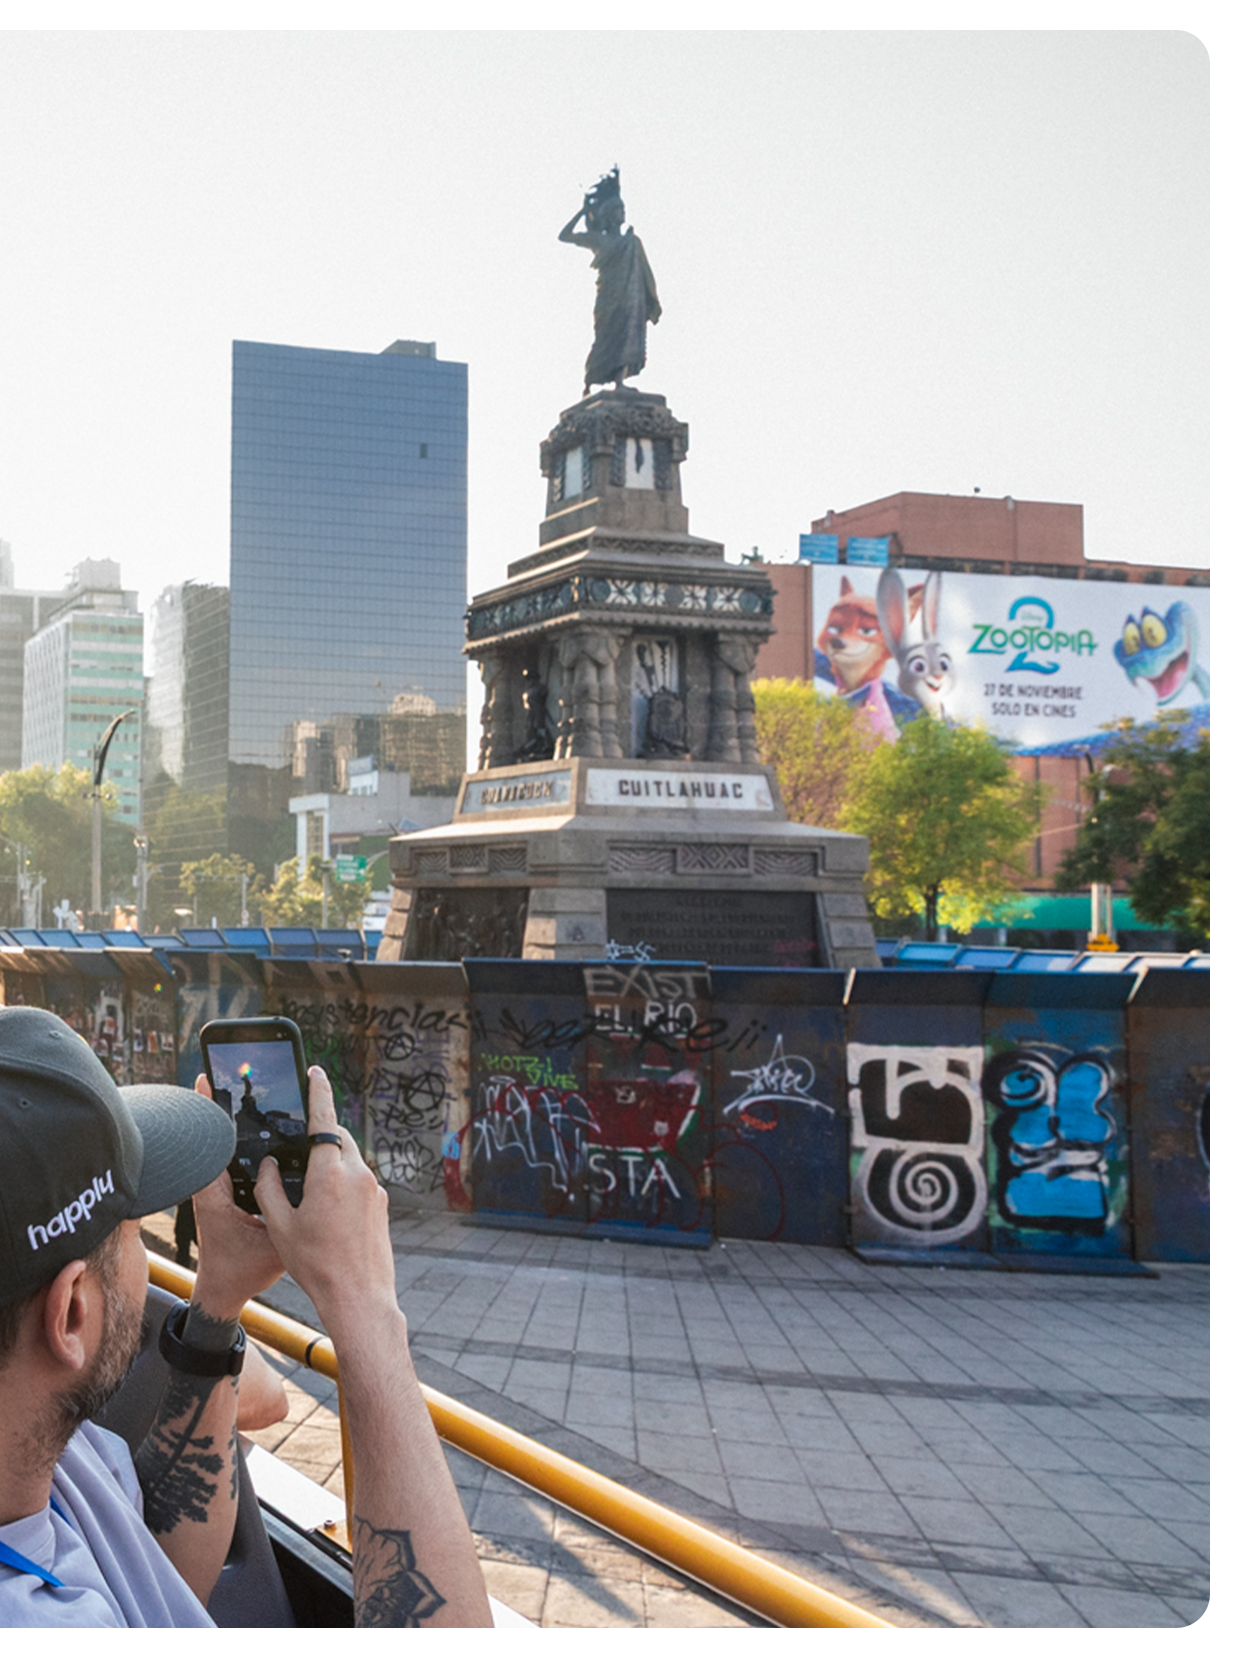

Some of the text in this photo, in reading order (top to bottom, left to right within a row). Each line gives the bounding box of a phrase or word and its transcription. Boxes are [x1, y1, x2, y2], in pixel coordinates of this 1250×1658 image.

[984, 683, 1082, 700] 27 DE NOVIEMBRE
[992, 702, 1076, 718] SOLO EN CINES
[618, 779, 743, 799] CUITLAHUAC
[27, 1169, 114, 1250] happly
